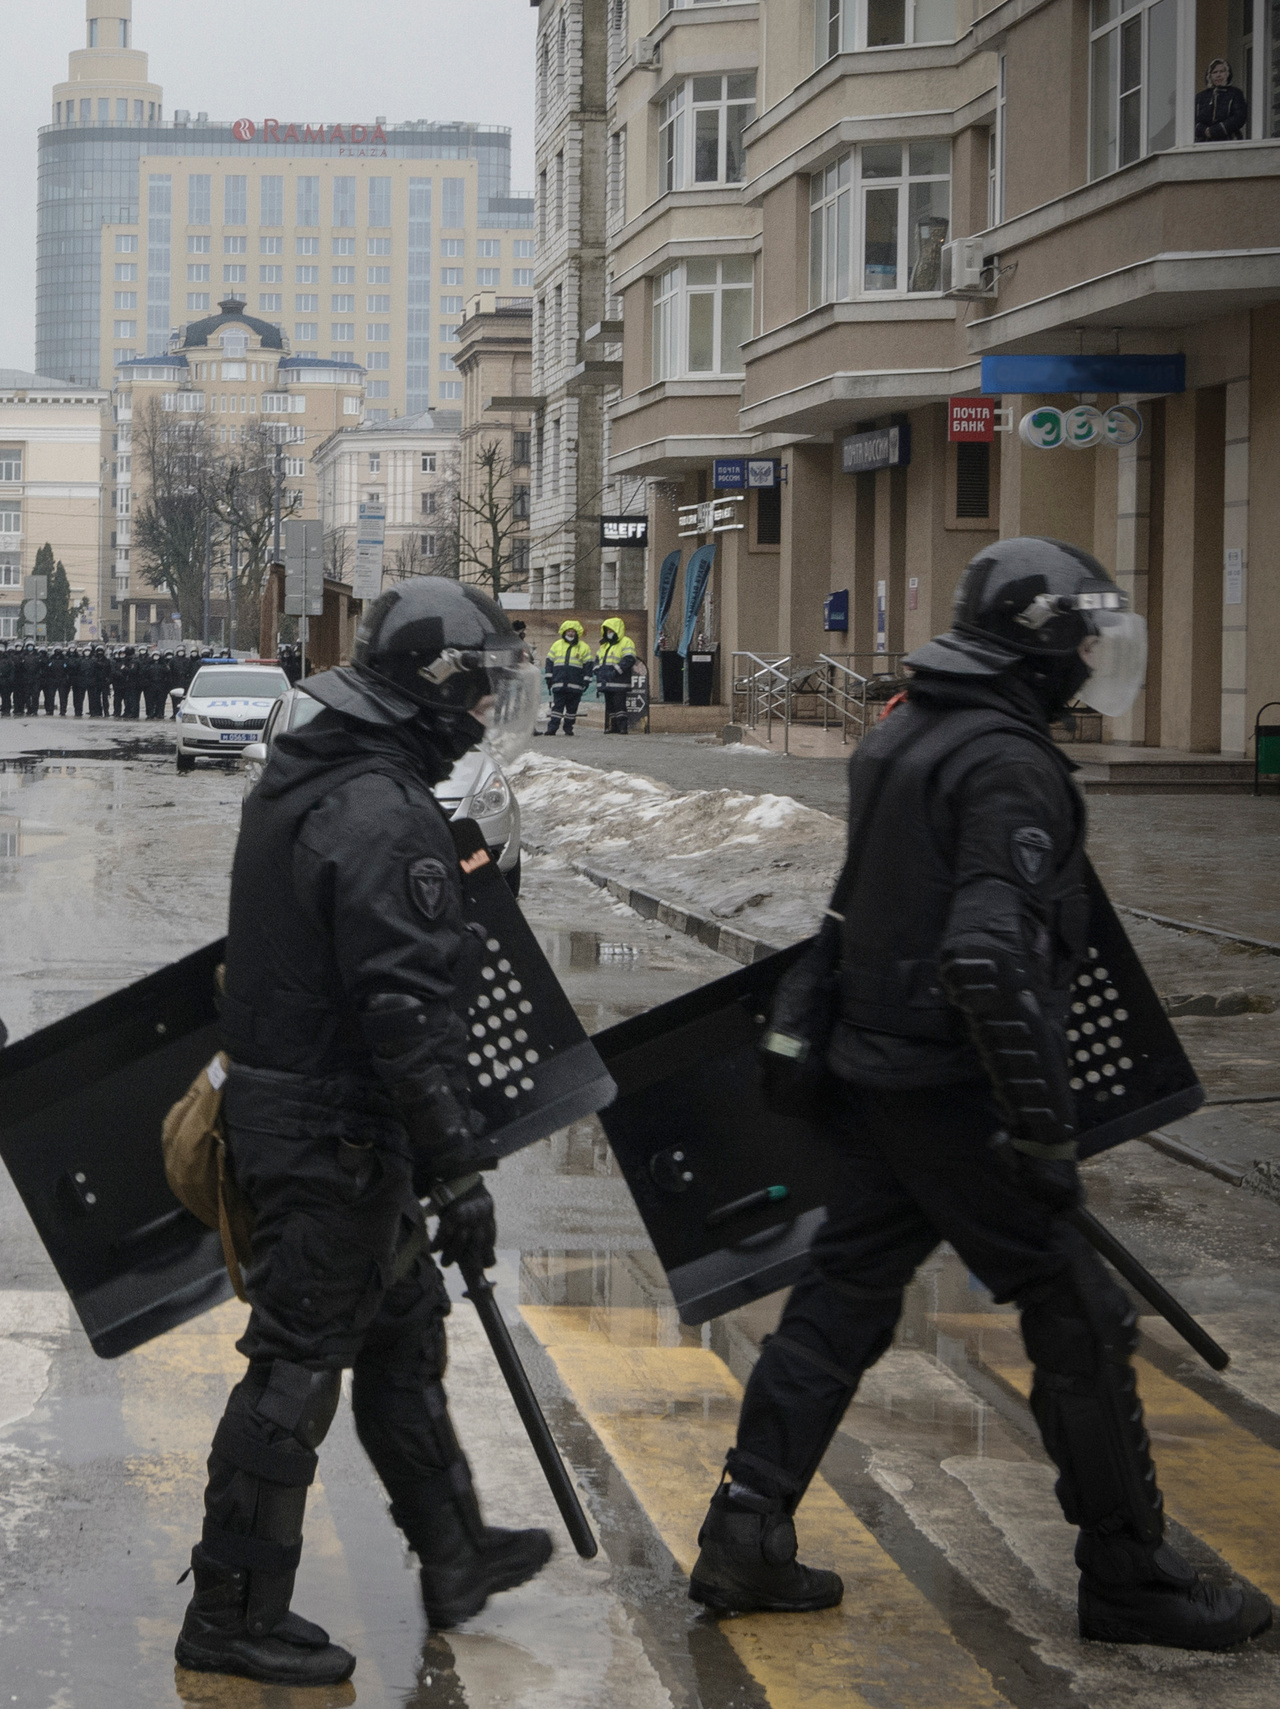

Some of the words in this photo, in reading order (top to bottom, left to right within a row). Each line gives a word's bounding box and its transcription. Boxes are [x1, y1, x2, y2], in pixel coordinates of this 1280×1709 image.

[263, 118, 387, 143] RAMADA
[339, 148, 388, 157] PLAZA
[953, 407, 990, 419] ПОЧТА
[953, 421, 985, 432] БАНК
[207, 700, 270, 708] ДПС
